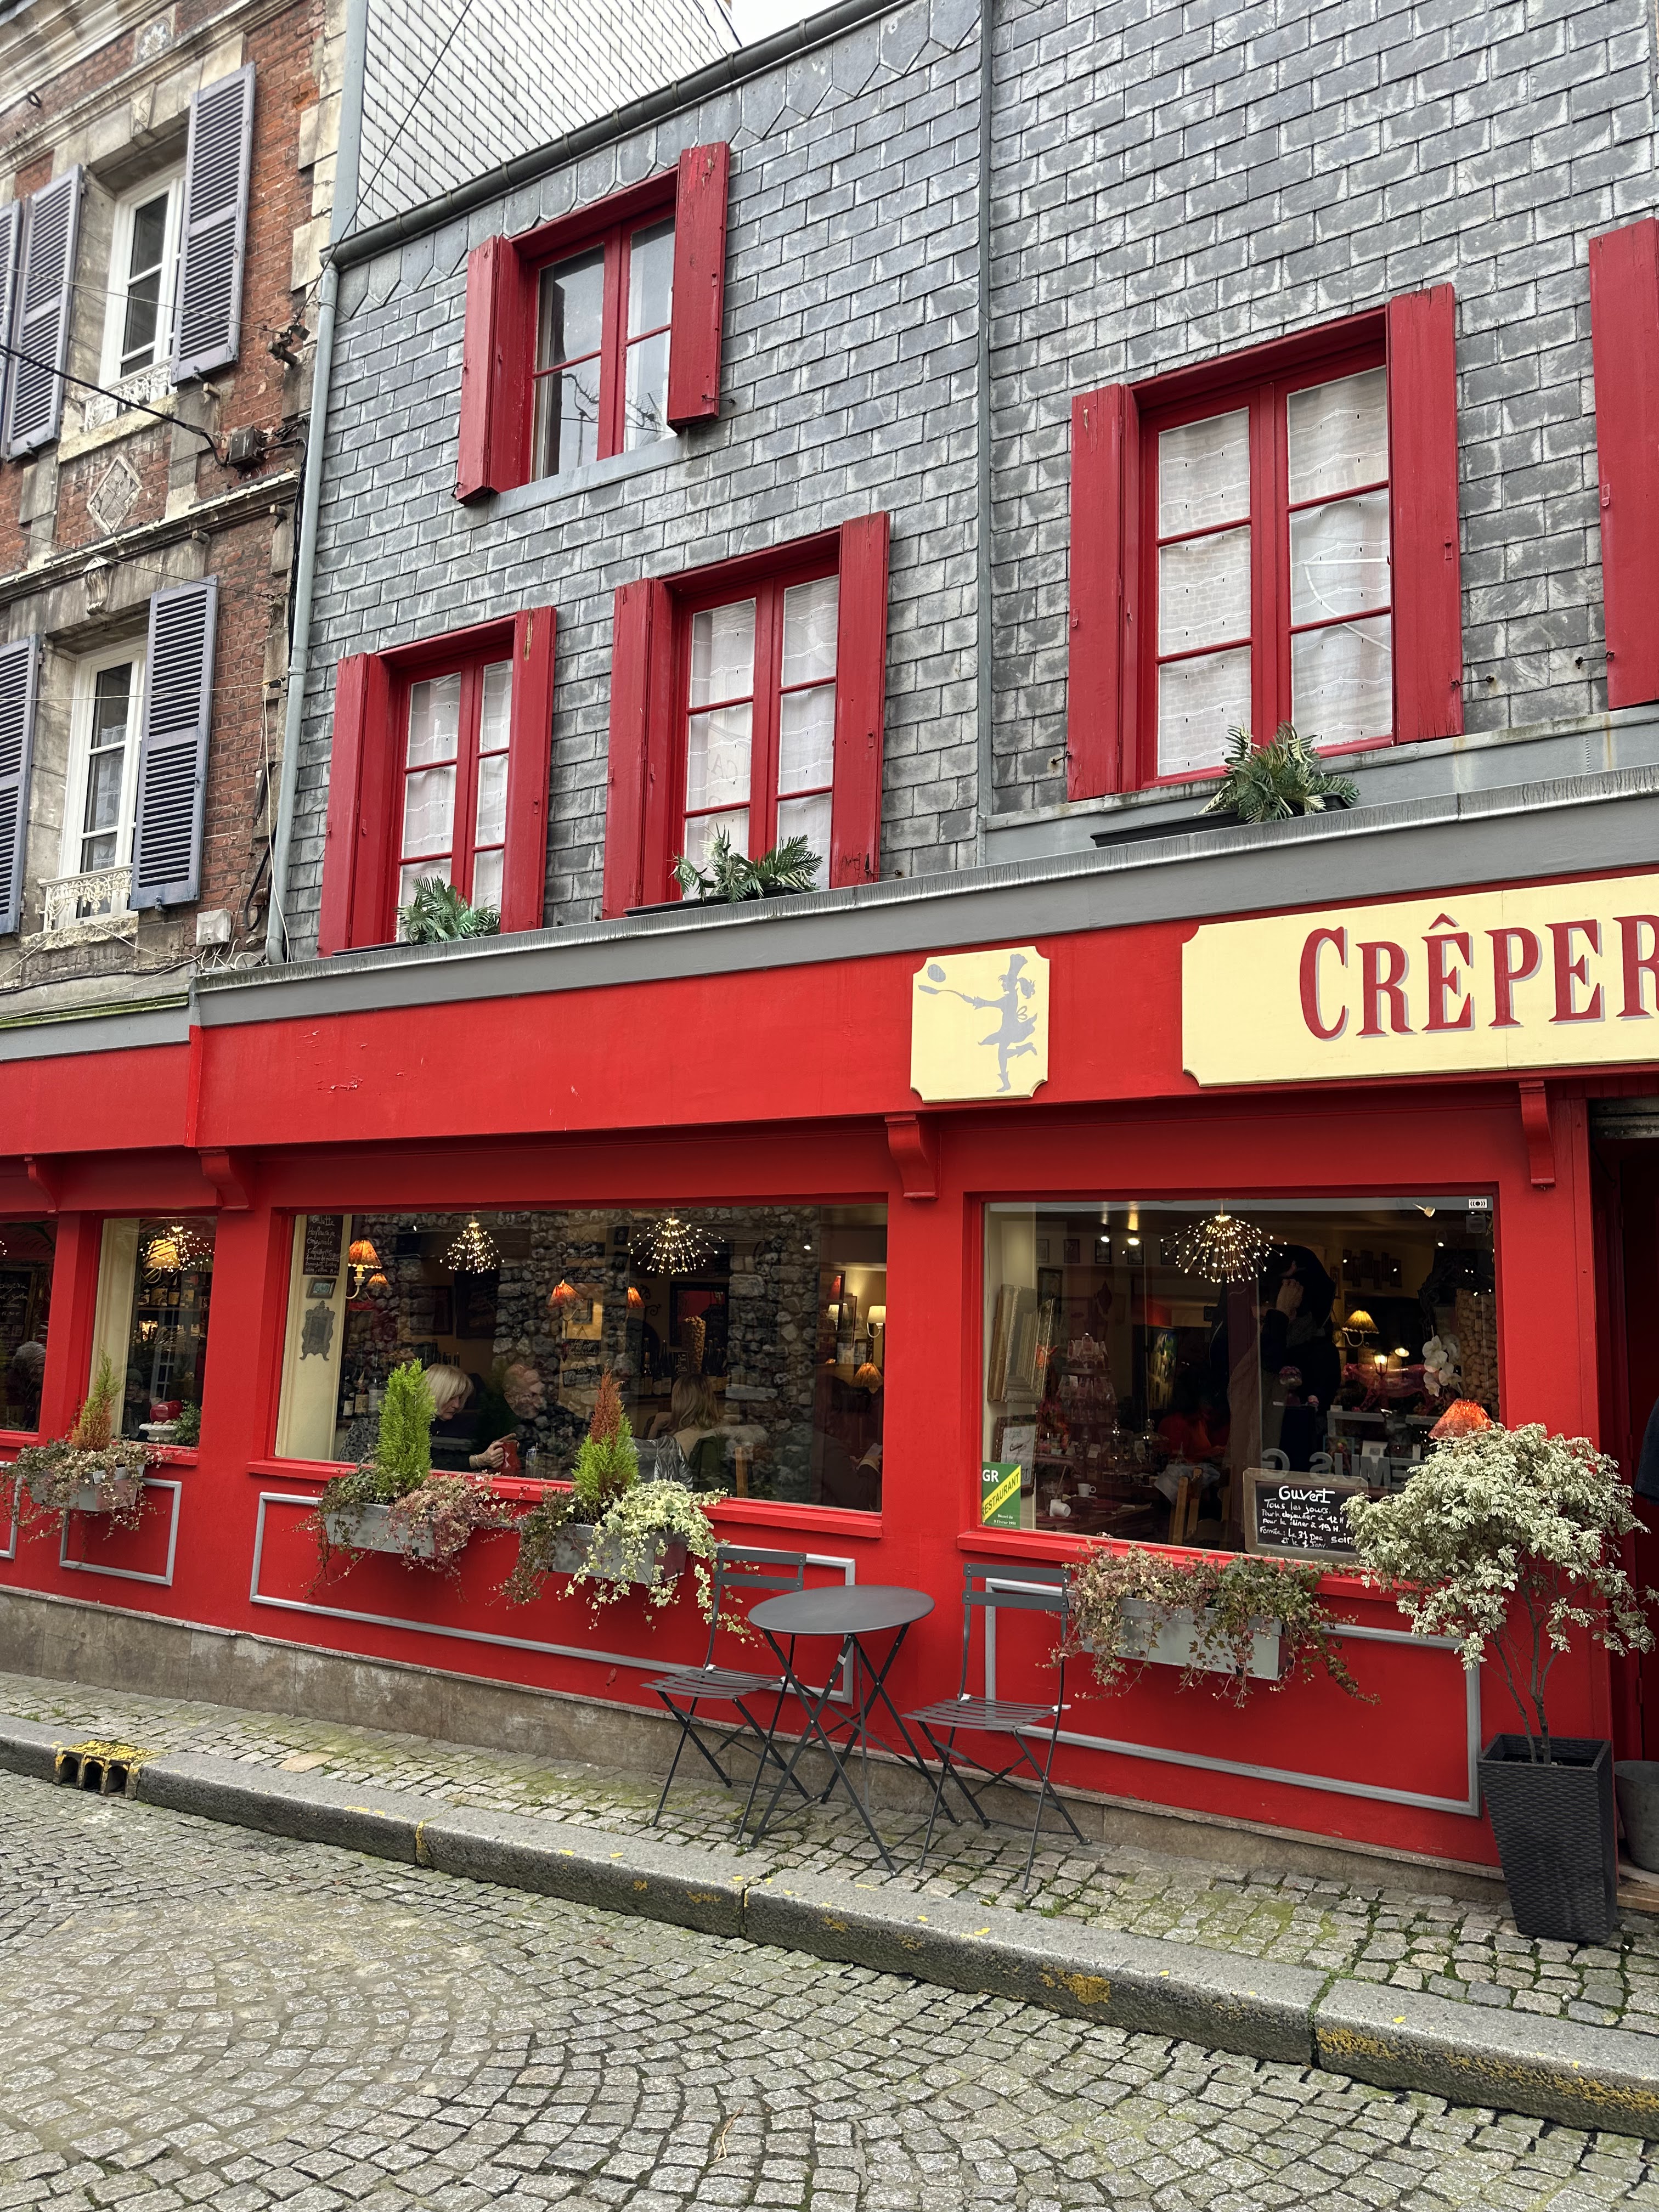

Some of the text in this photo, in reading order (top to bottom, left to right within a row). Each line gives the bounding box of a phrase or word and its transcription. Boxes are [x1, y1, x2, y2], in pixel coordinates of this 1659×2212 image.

[983, 1469, 999, 1483] GR
[981, 1472, 1020, 1517] RESTAURANT
[1264, 1498, 1286, 1509] Tous
[1290, 1502, 1301, 1511] les
[1327, 1515, 1339, 1524] 12
[1318, 1523, 1331, 1532] 19
[1297, 1530, 1308, 1539] 31
[1330, 1533, 1353, 1544] soir
